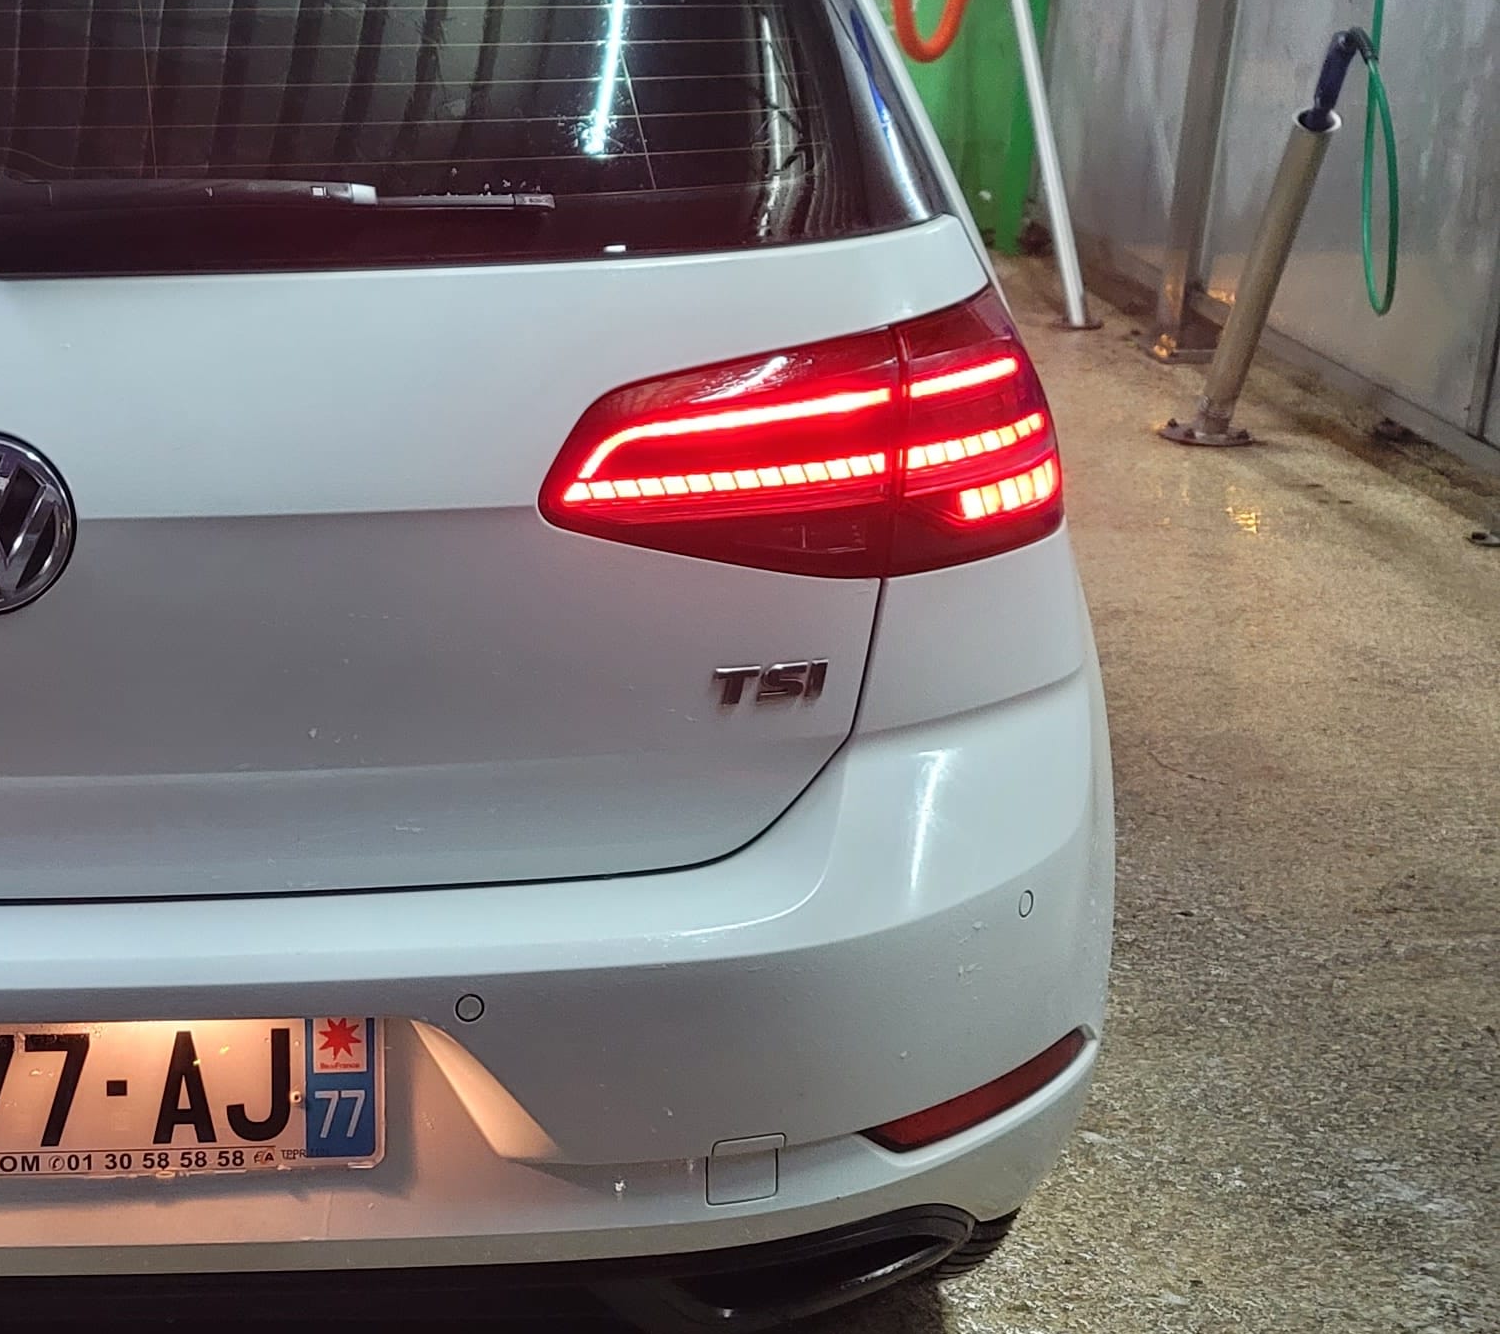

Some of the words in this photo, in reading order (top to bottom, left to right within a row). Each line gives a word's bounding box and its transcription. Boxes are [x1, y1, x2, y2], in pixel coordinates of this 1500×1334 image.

[712, 658, 829, 706] TSI
[315, 1089, 365, 1138] 77
[67, 1154, 93, 1171] 01
[105, 1153, 132, 1170] 30
[142, 1152, 170, 1169] 58
[180, 1151, 208, 1168] 58
[217, 1150, 245, 1167] 58
